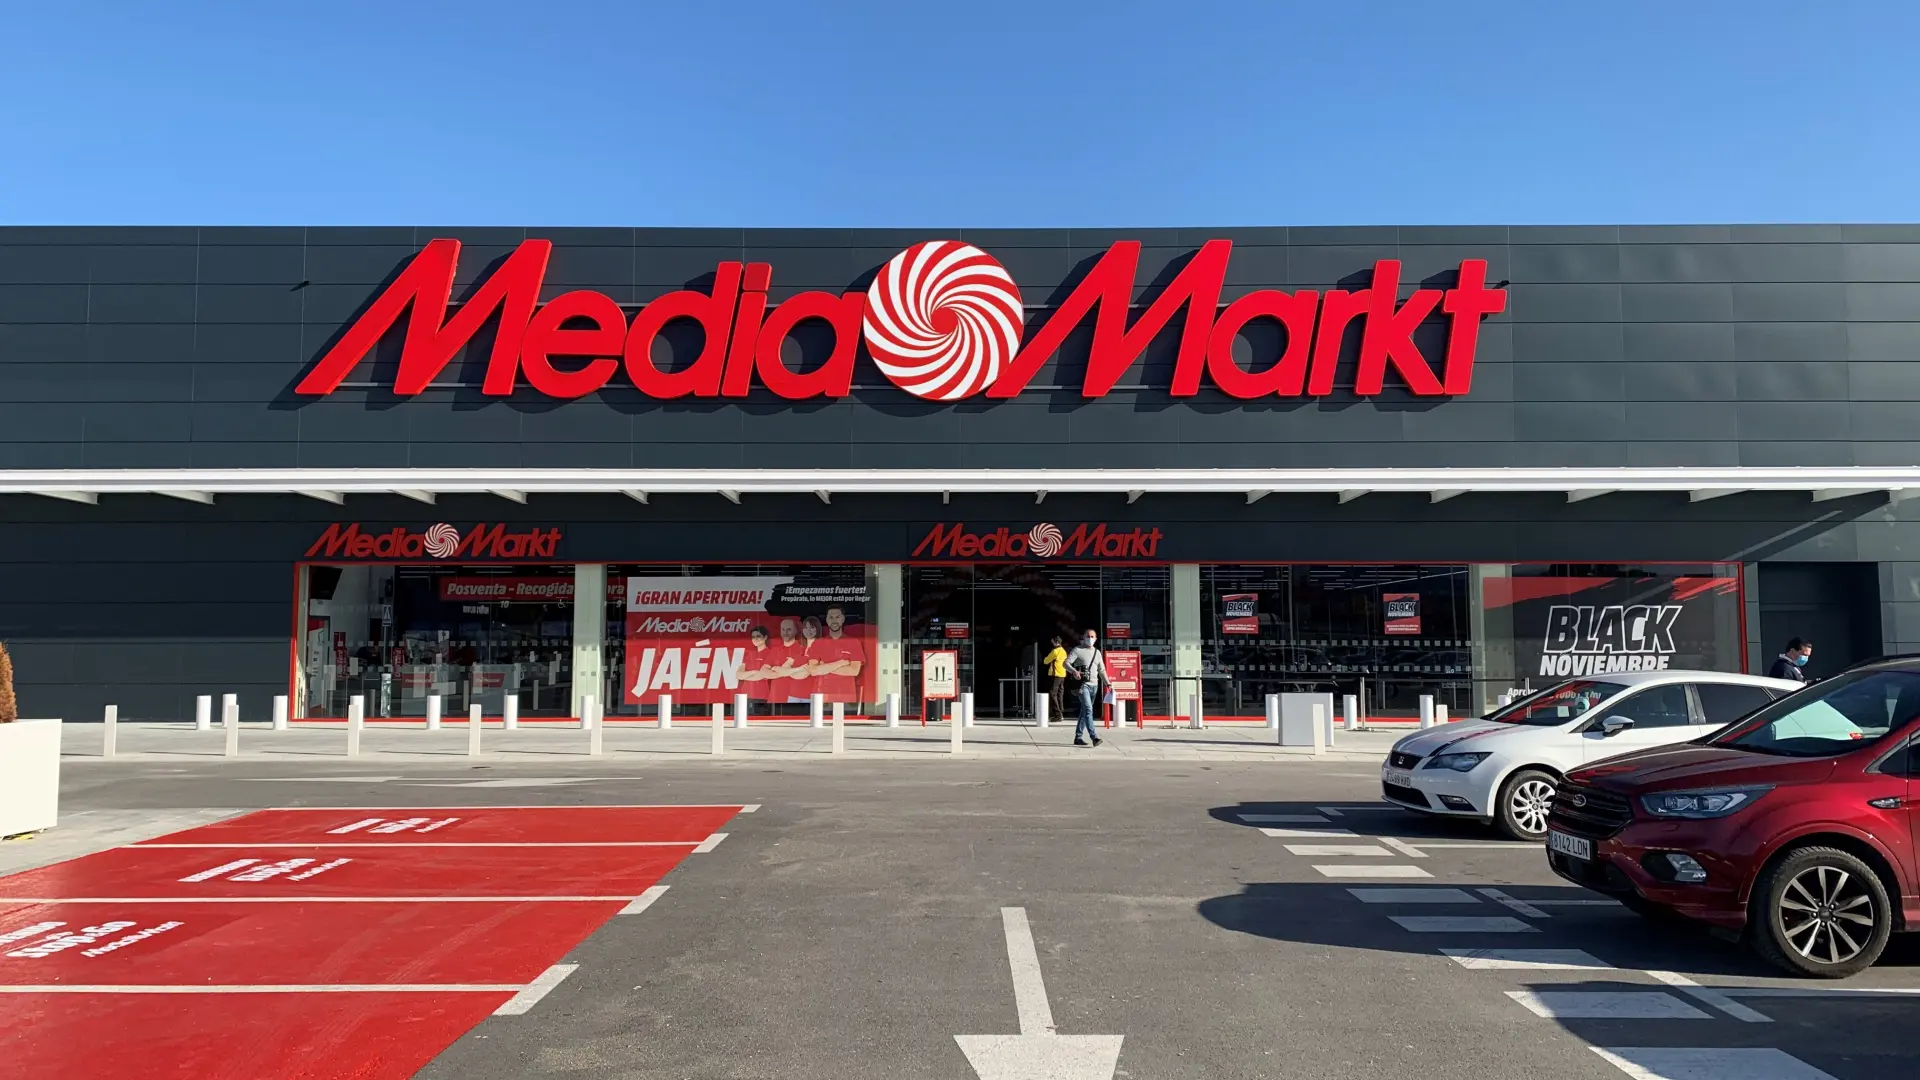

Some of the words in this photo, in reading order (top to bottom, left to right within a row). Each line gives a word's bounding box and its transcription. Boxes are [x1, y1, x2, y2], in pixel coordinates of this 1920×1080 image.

[447, 583, 506, 595] Posventa
[516, 582, 574, 597] Recogida
[785, 586, 833, 595] ¡Empezamos
[834, 585, 867, 594] fuertes!
[635, 590, 681, 605] ¡GRAN
[682, 590, 763, 605] APERTURA!
[1227, 601, 1254, 611] BLACK
[1388, 601, 1416, 612] BLACK
[1543, 605, 1682, 653] BLACK
[631, 638, 745, 698] JAÉN
[1539, 655, 1670, 676] NOVIEMBRE
[1553, 833, 1571, 852] 8142
[1572, 838, 1588, 857] LDN
